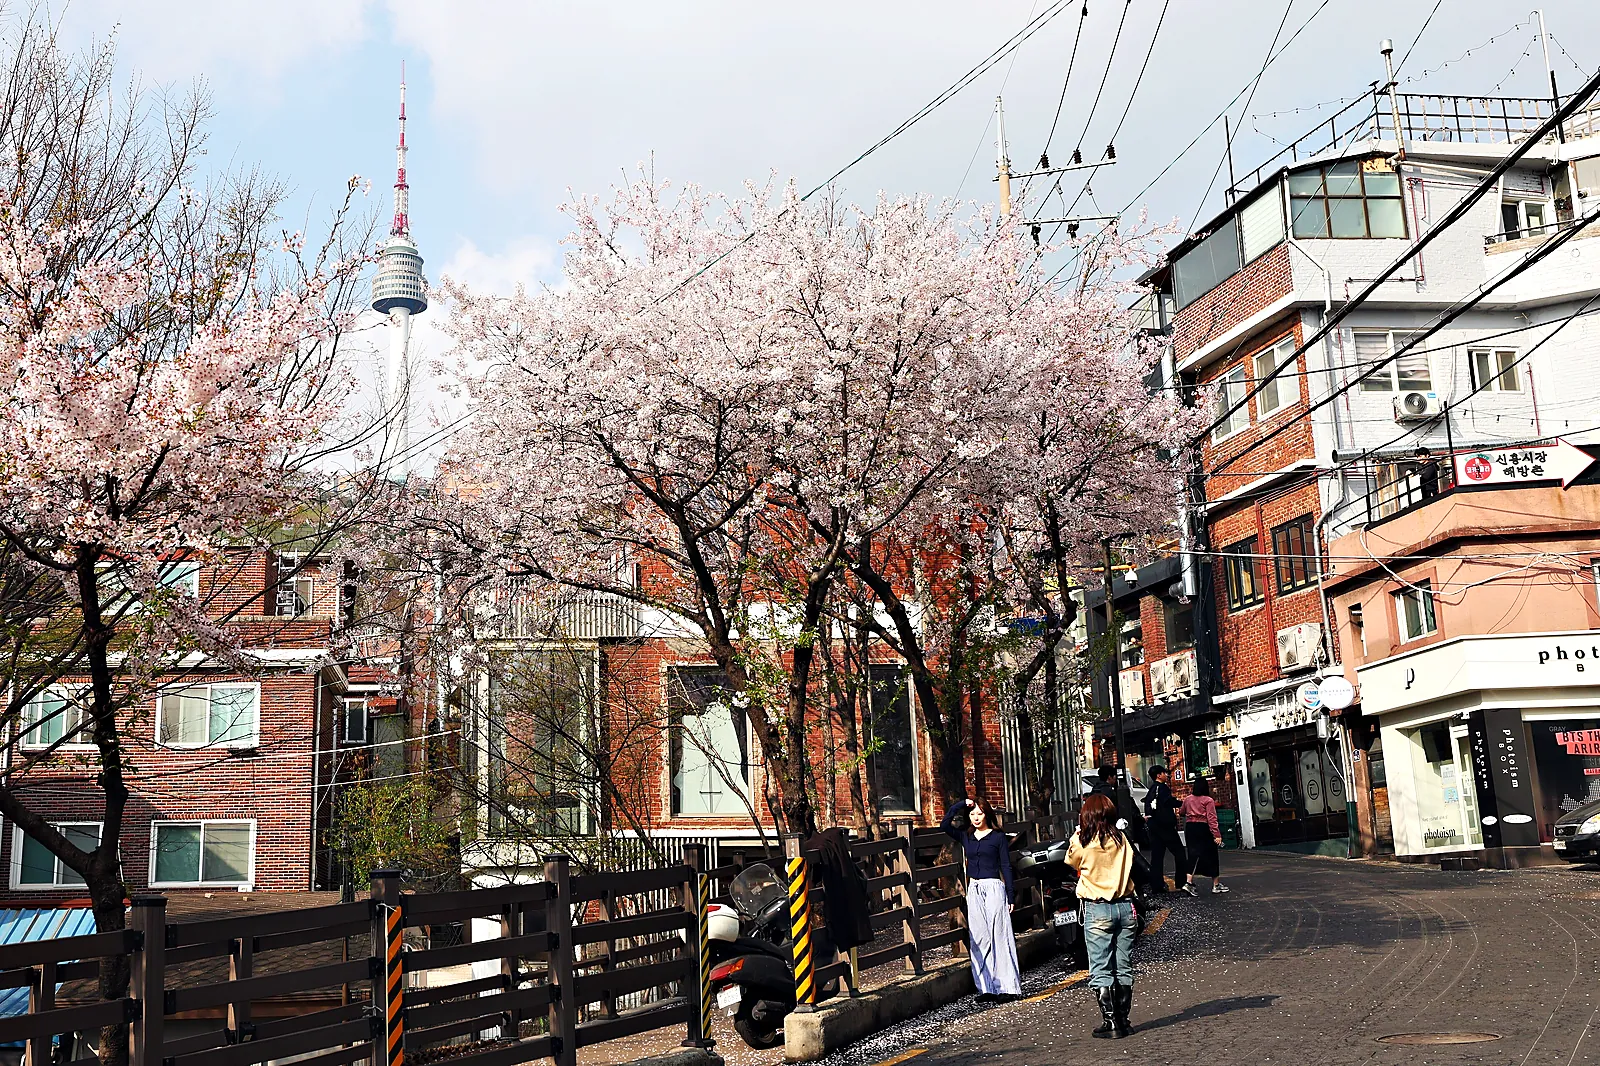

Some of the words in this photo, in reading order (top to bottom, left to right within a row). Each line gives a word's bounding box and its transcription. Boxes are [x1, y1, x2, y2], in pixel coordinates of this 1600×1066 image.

[1495, 451, 1547, 466] 신흥시장
[1503, 465, 1544, 478] 해방촌
[1538, 645, 1600, 665] phot
[1562, 731, 1584, 743] BTS
[1498, 743, 1509, 774] BOX
[1502, 729, 1519, 788] photoism
[1424, 826, 1456, 844] photoism
